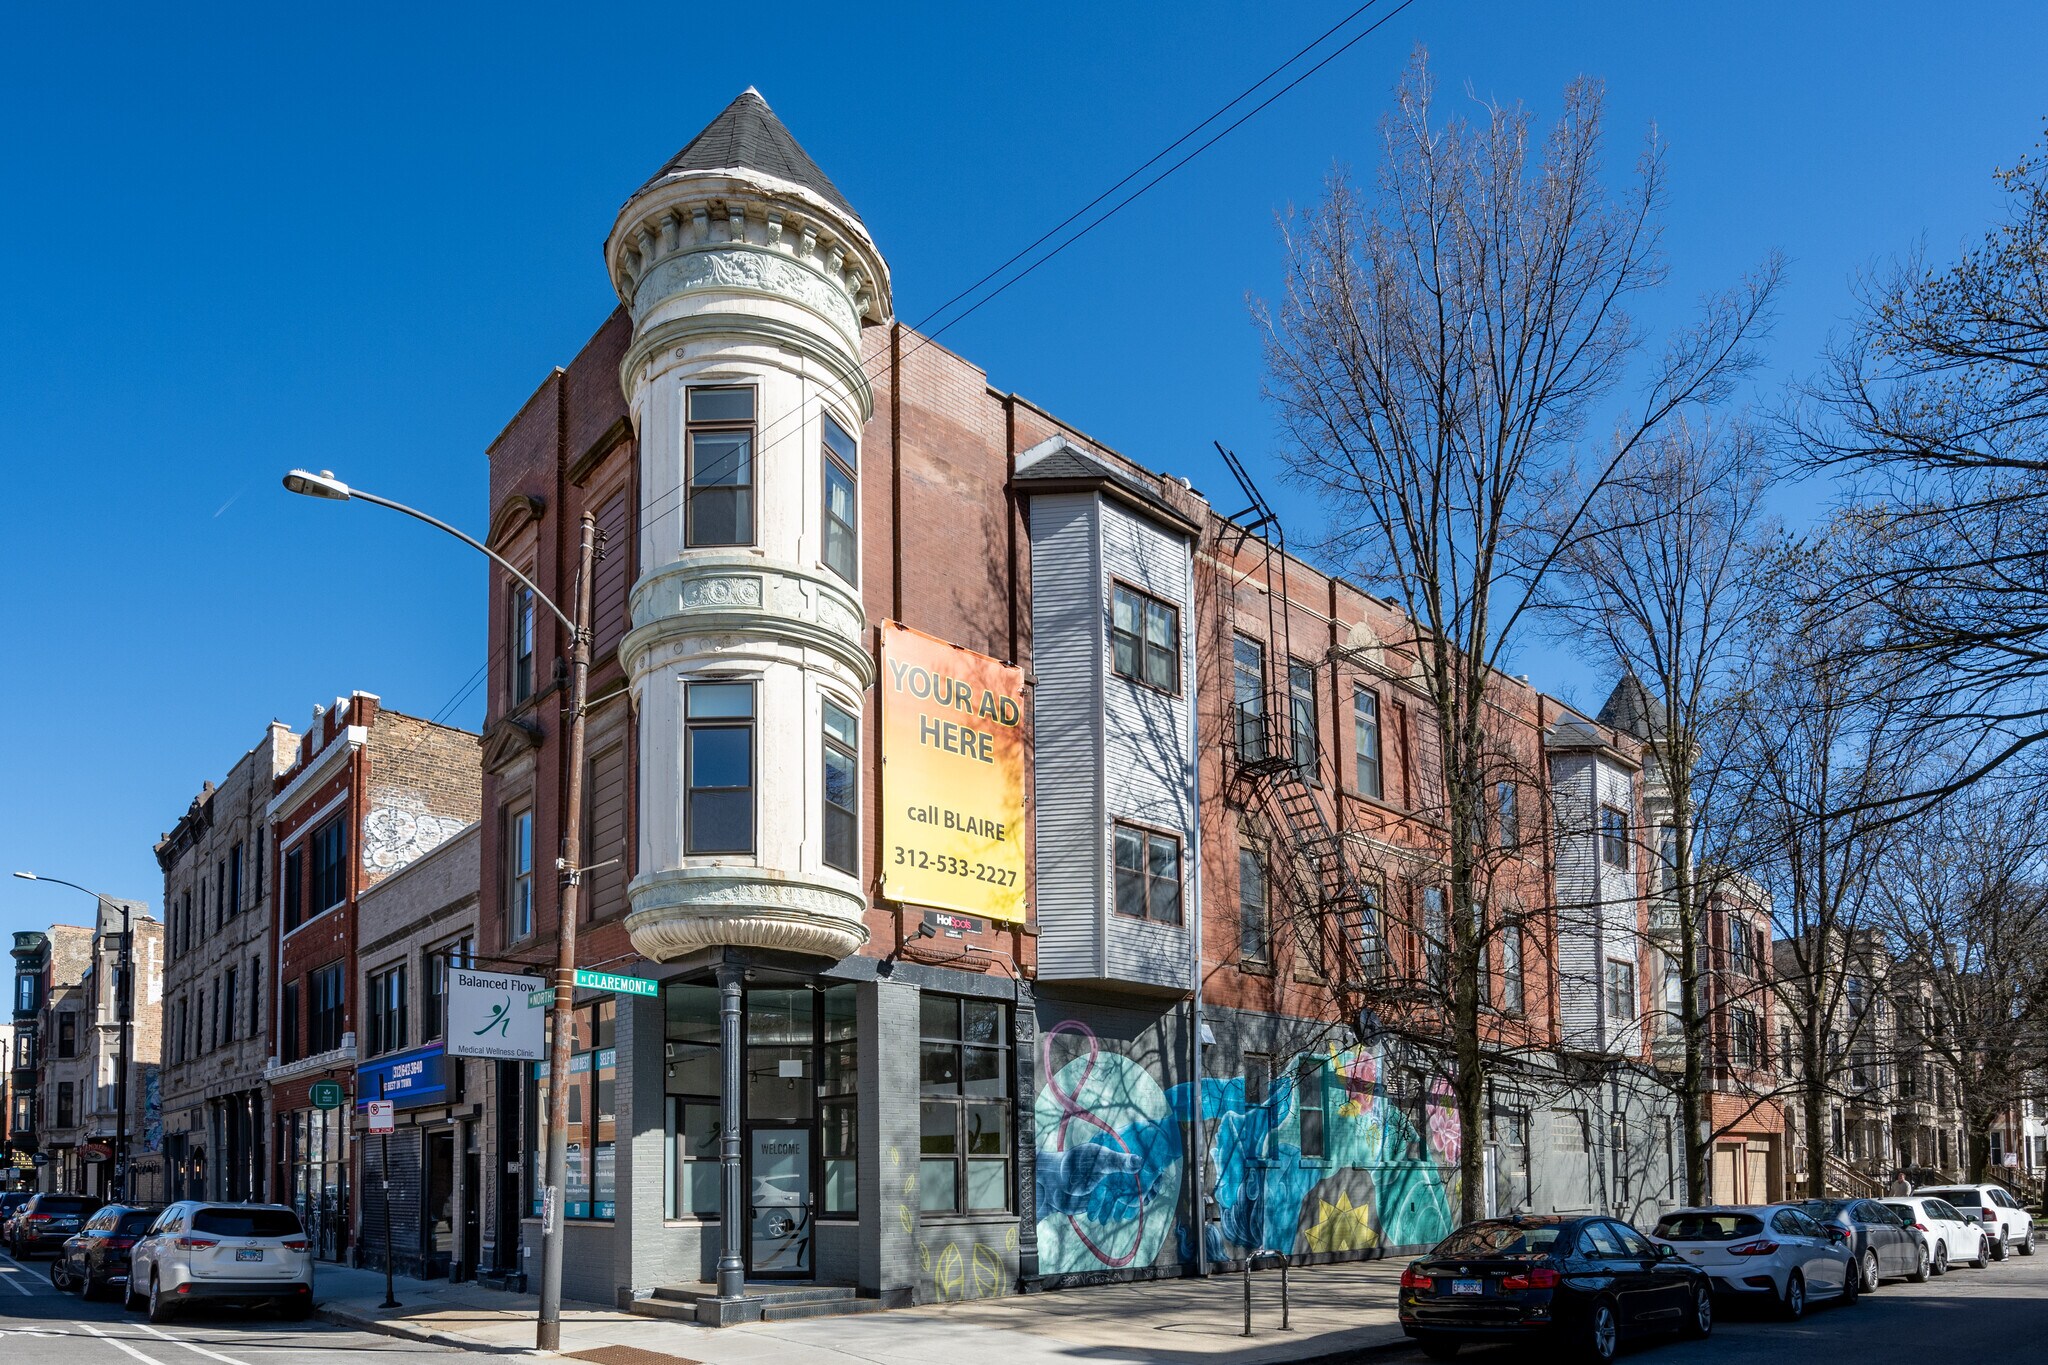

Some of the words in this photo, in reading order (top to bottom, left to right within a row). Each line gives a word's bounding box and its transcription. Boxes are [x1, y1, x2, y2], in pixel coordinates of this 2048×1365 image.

[888, 658, 974, 715] YOUR
[978, 690, 1021, 728] AD
[919, 713, 995, 765] HERE
[907, 805, 939, 825] call
[944, 810, 1006, 842] BLAIRE
[894, 846, 1017, 887] 312-533-2227
[458, 974, 508, 990] Balanced
[510, 979, 536, 992] Flow
[581, 975, 586, 983] N
[588, 974, 647, 993] CLAREMONT
[533, 991, 552, 1005] NORTH
[458, 1045, 485, 1055] Medical
[485, 1047, 515, 1057] Wellness
[516, 1049, 535, 1057] Clinic
[580, 1056, 590, 1070] BEST
[761, 1143, 800, 1155] WELCOME
